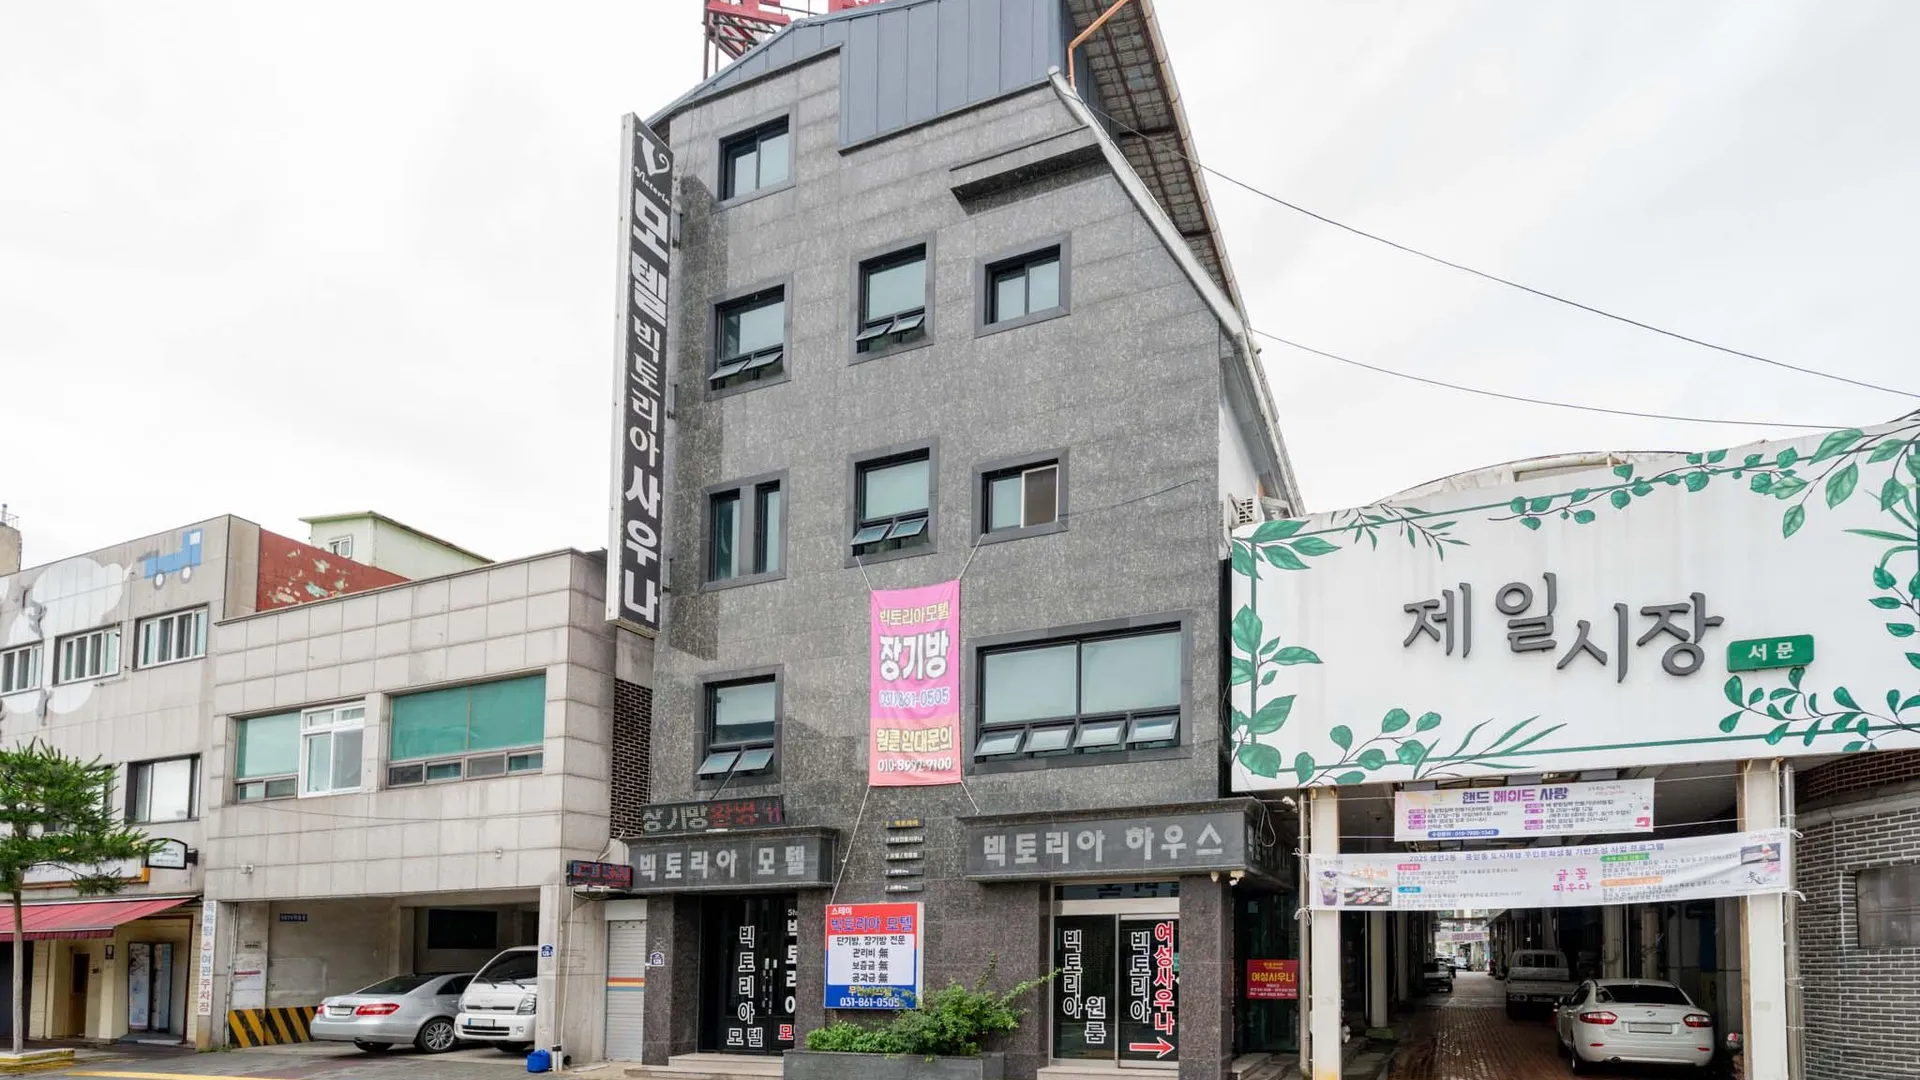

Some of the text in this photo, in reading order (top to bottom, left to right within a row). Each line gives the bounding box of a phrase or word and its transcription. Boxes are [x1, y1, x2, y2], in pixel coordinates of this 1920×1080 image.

[631, 187, 668, 328] 모텔
[630, 315, 661, 467] 빅토리아
[624, 464, 661, 624] 사우나
[1403, 572, 1725, 683] 제일시장
[879, 629, 950, 681] 장기방
[1748, 641, 1797, 662] 서문
[1462, 787, 1569, 804] 핸드 메이드 사랑
[984, 822, 1223, 867] 빅토리아 하우스
[1630, 842, 1665, 853] 프로그램
[639, 849, 736, 882] 빅토리아
[757, 845, 805, 876] 모텔
[831, 907, 853, 915] 스테이
[831, 915, 913, 932] 빅토리아 모텔
[852, 948, 889, 959] 관리비 無
[864, 935, 887, 946] 장기방
[890, 935, 906, 945] 전문
[737, 925, 756, 1025] 빅토리아
[852, 960, 889, 971] 보증금 無
[852, 972, 889, 984] 공과금 無
[1063, 930, 1083, 1019] 빅토리아
[1130, 931, 1152, 1024] 빅토리아
[1154, 921, 1176, 1036] 여성사우나
[1251, 972, 1295, 983] 여성사우나
[199, 979, 211, 1013] 주차장
[839, 997, 900, 1007] 031-861-0505
[1085, 996, 1107, 1044] 원룸
[727, 1027, 763, 1048] 모텔
